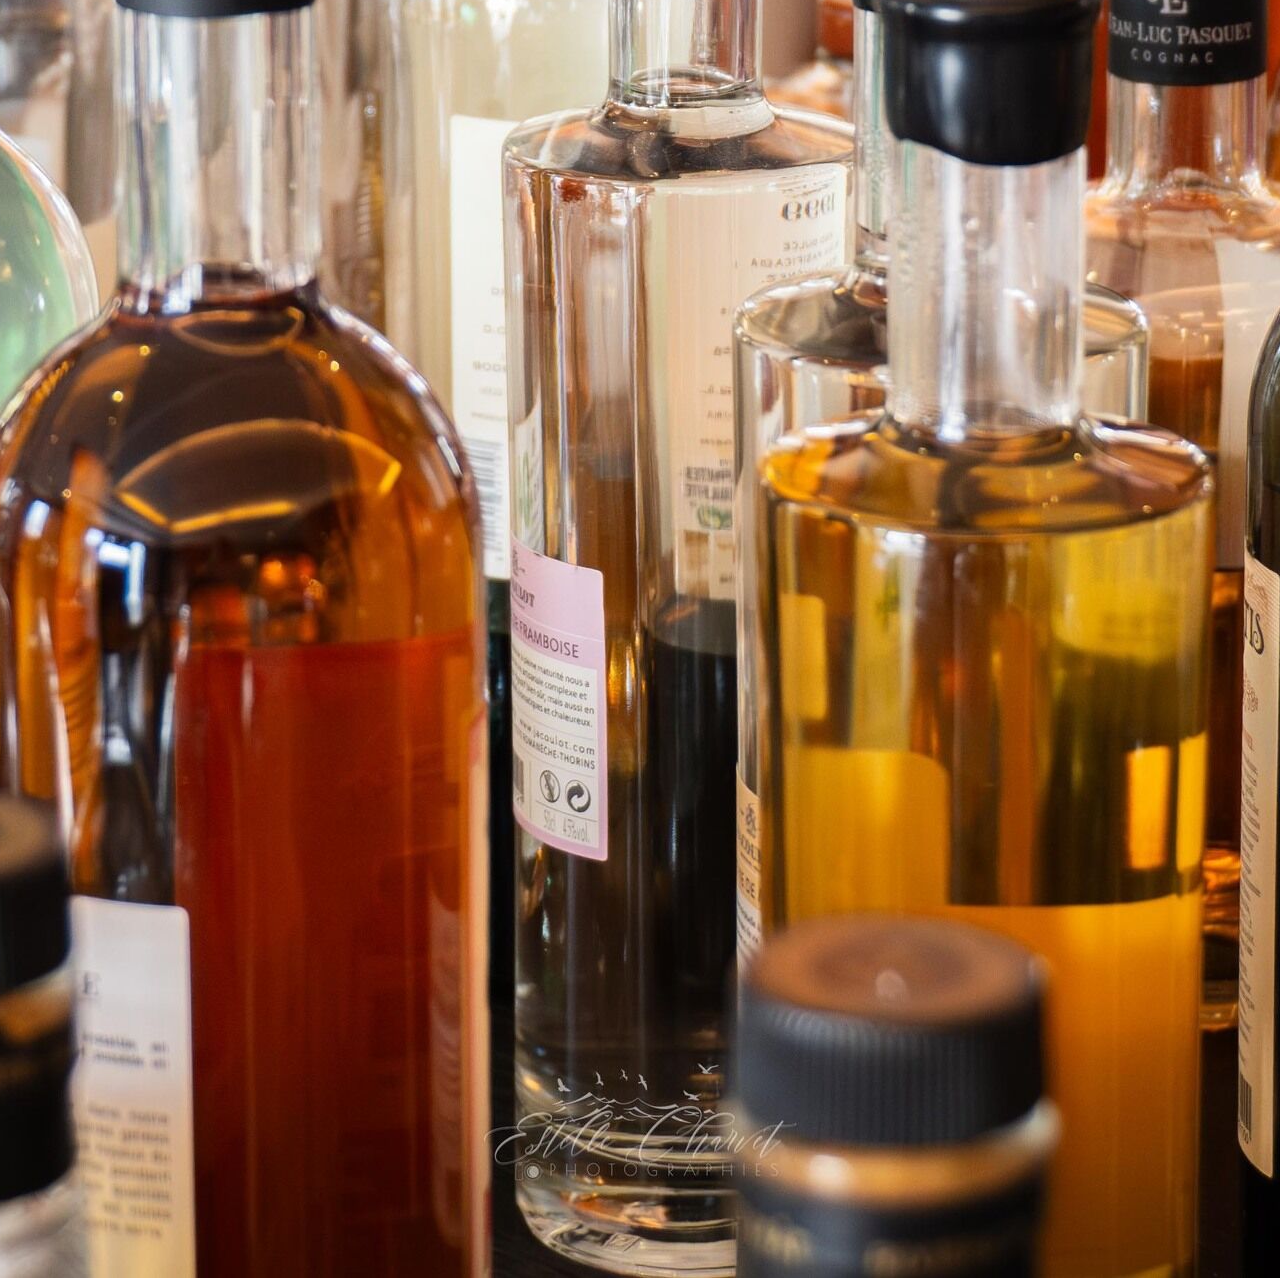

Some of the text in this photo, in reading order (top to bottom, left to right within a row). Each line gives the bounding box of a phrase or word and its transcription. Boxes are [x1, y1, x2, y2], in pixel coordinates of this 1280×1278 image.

[1176, 22, 1252, 46] PASQUET
[1131, 47, 1214, 64] COGNAC
[519, 620, 580, 659] FRAMBOISE
[565, 675, 584, 687] nous
[545, 682, 578, 699] complexe
[564, 702, 583, 713] aussi
[584, 706, 595, 715] en
